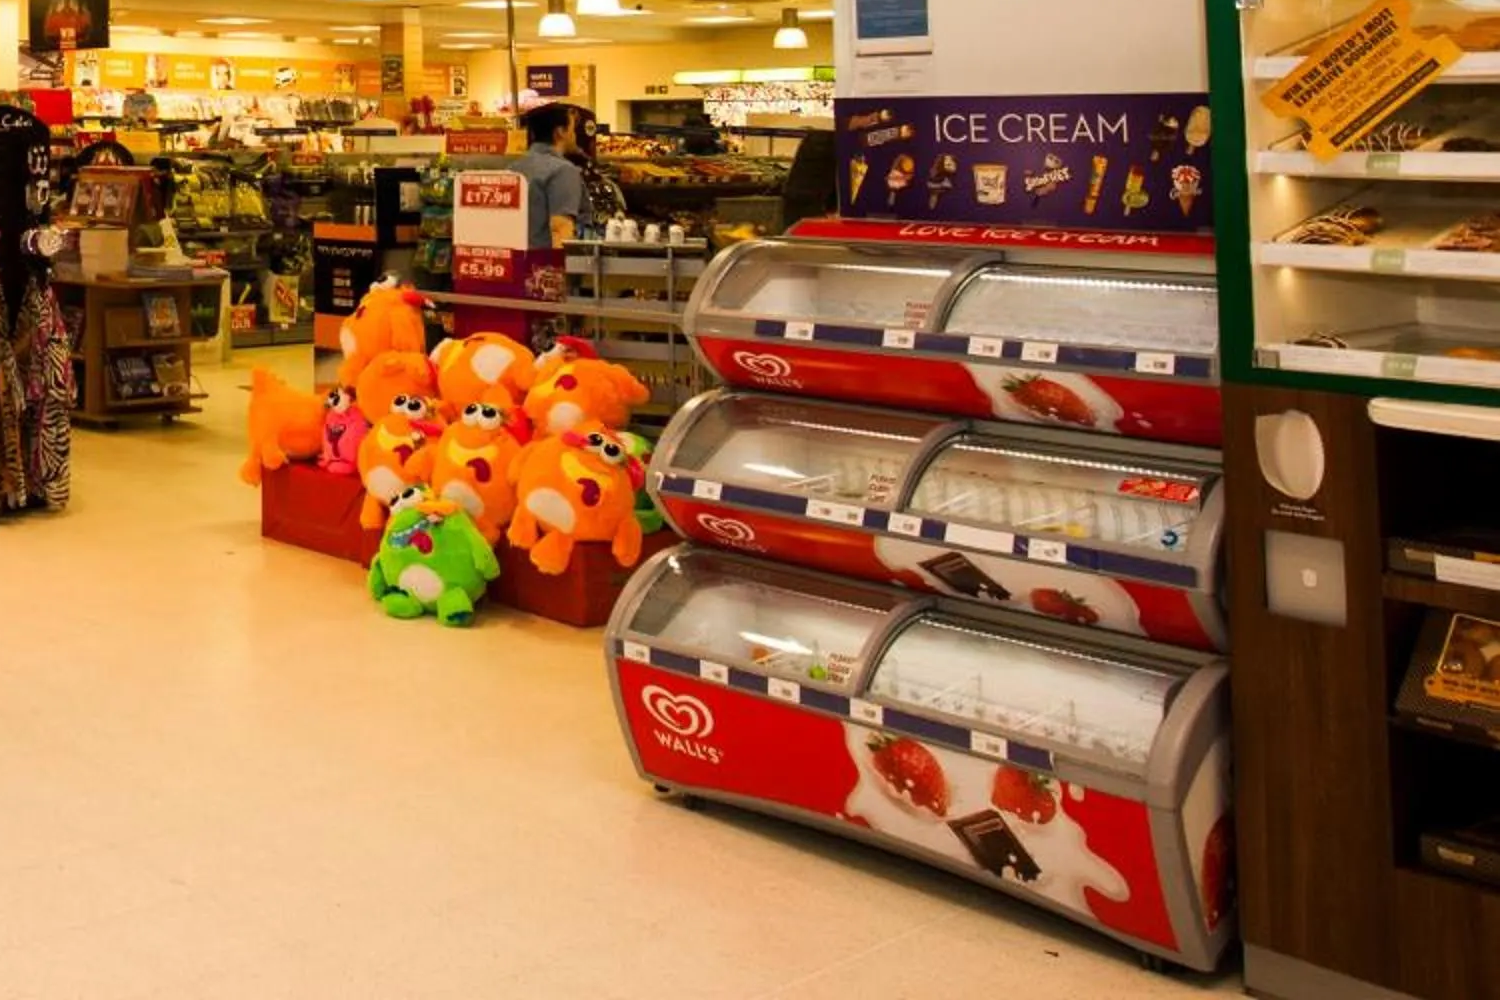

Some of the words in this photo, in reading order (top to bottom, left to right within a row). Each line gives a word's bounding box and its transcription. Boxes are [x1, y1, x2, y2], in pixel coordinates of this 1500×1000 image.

[1363, 7, 1394, 35] MOST
[933, 113, 989, 145] ICE
[997, 113, 1129, 145] CREAM
[459, 262, 506, 278] £5.99
[754, 376, 803, 390] WALL'S
[653, 729, 722, 765] WALL'S
